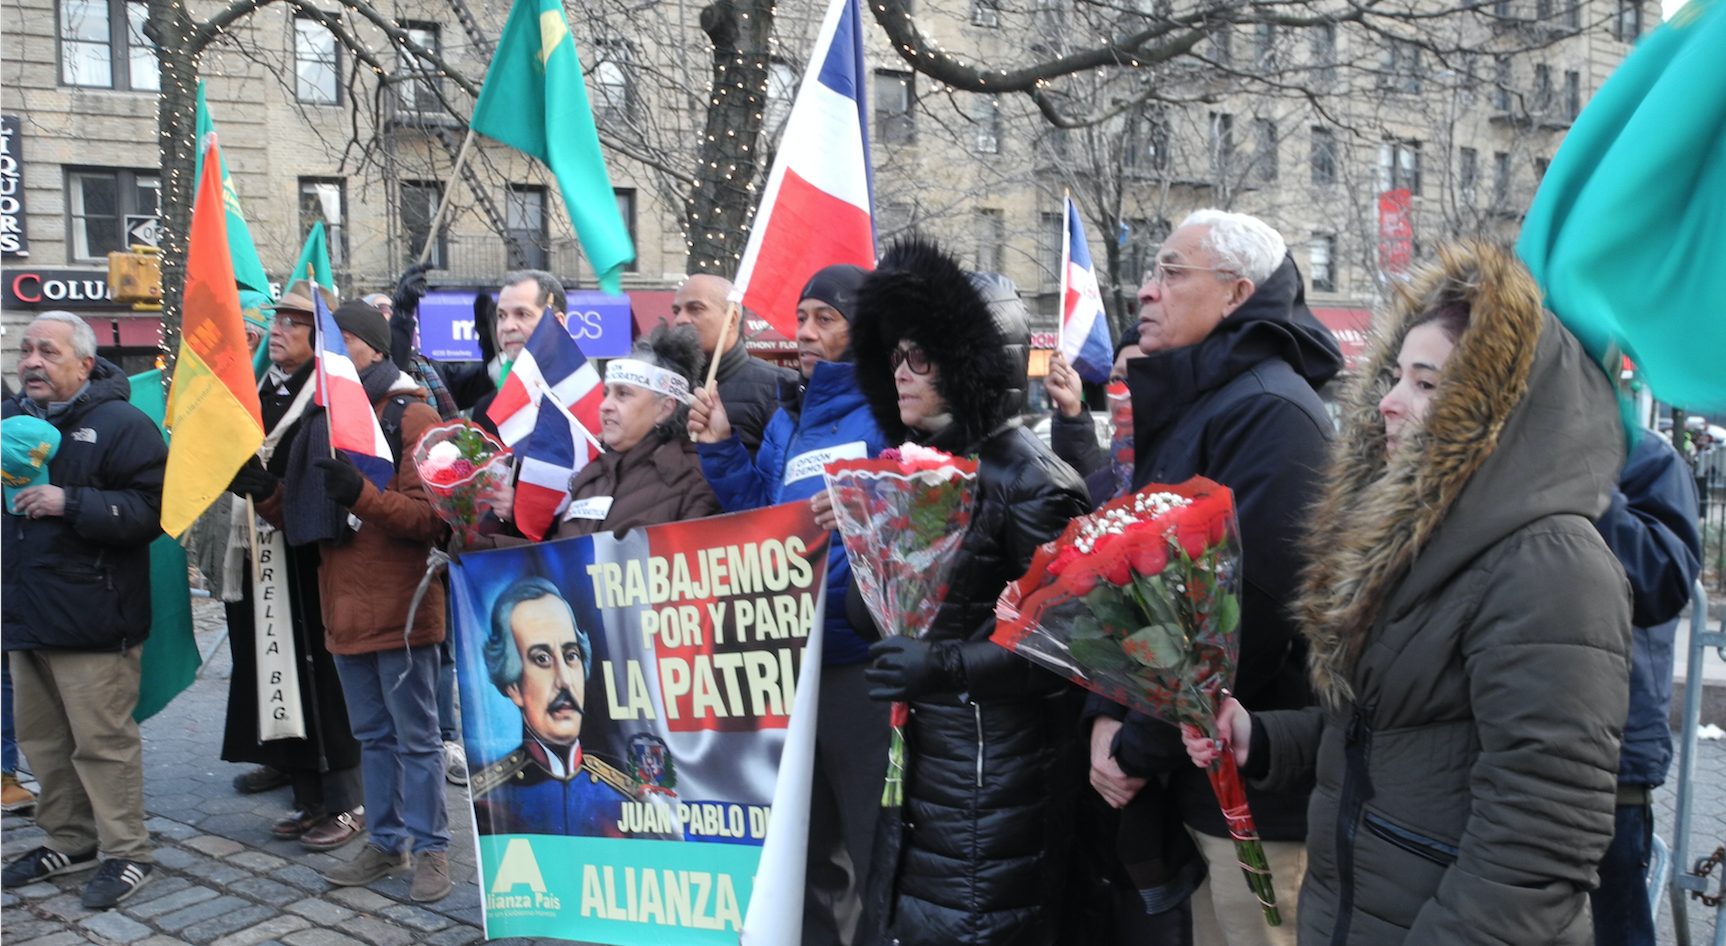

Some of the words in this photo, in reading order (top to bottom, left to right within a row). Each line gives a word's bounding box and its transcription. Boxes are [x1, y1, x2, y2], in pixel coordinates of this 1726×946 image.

[12, 274, 110, 302] COLU
[257, 531, 279, 655] MBRELLA
[586, 535, 814, 609] TRABAJEMOS
[641, 604, 703, 649] POR
[707, 601, 726, 644] Y
[734, 592, 816, 642] PARA
[602, 659, 657, 720] LA
[617, 801, 673, 834] JUAN
[676, 803, 745, 839] PABLO
[487, 893, 531, 909] lianza
[580, 864, 743, 933] ALIANZA
